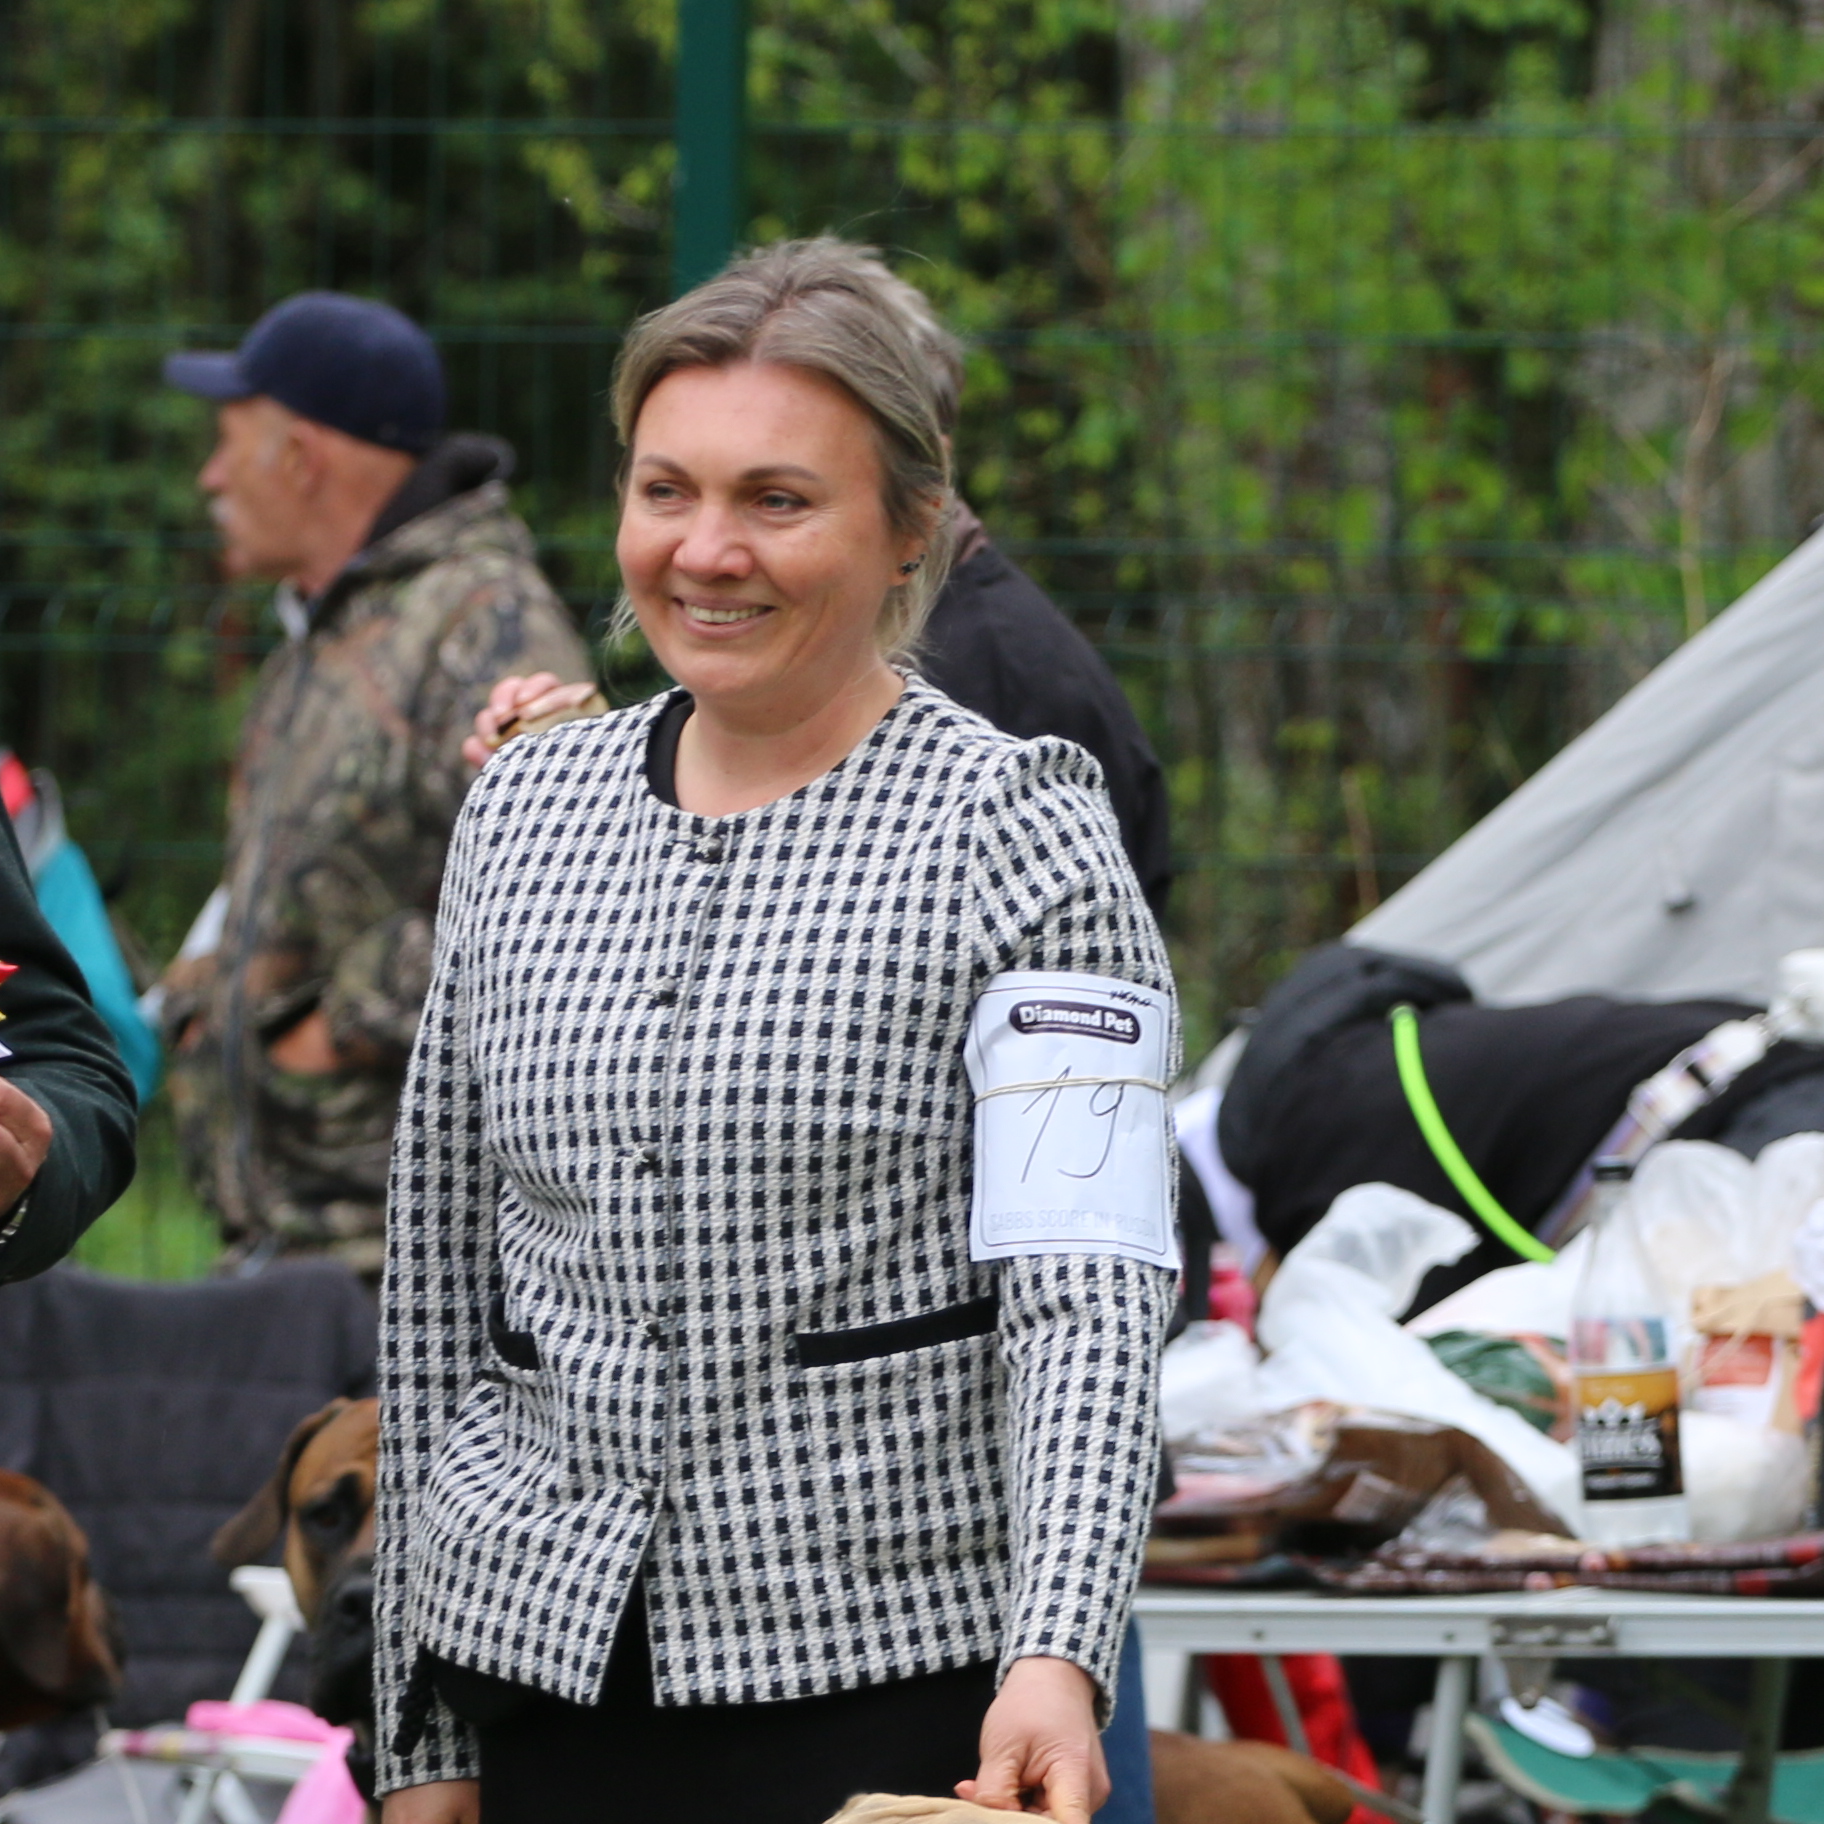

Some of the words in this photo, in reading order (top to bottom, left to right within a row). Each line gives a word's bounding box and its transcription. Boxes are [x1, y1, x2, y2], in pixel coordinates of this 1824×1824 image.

[1019, 1005, 1102, 1027] Diamond
[1104, 1011, 1134, 1033] Pet
[1038, 1208, 1090, 1229] SCORE
